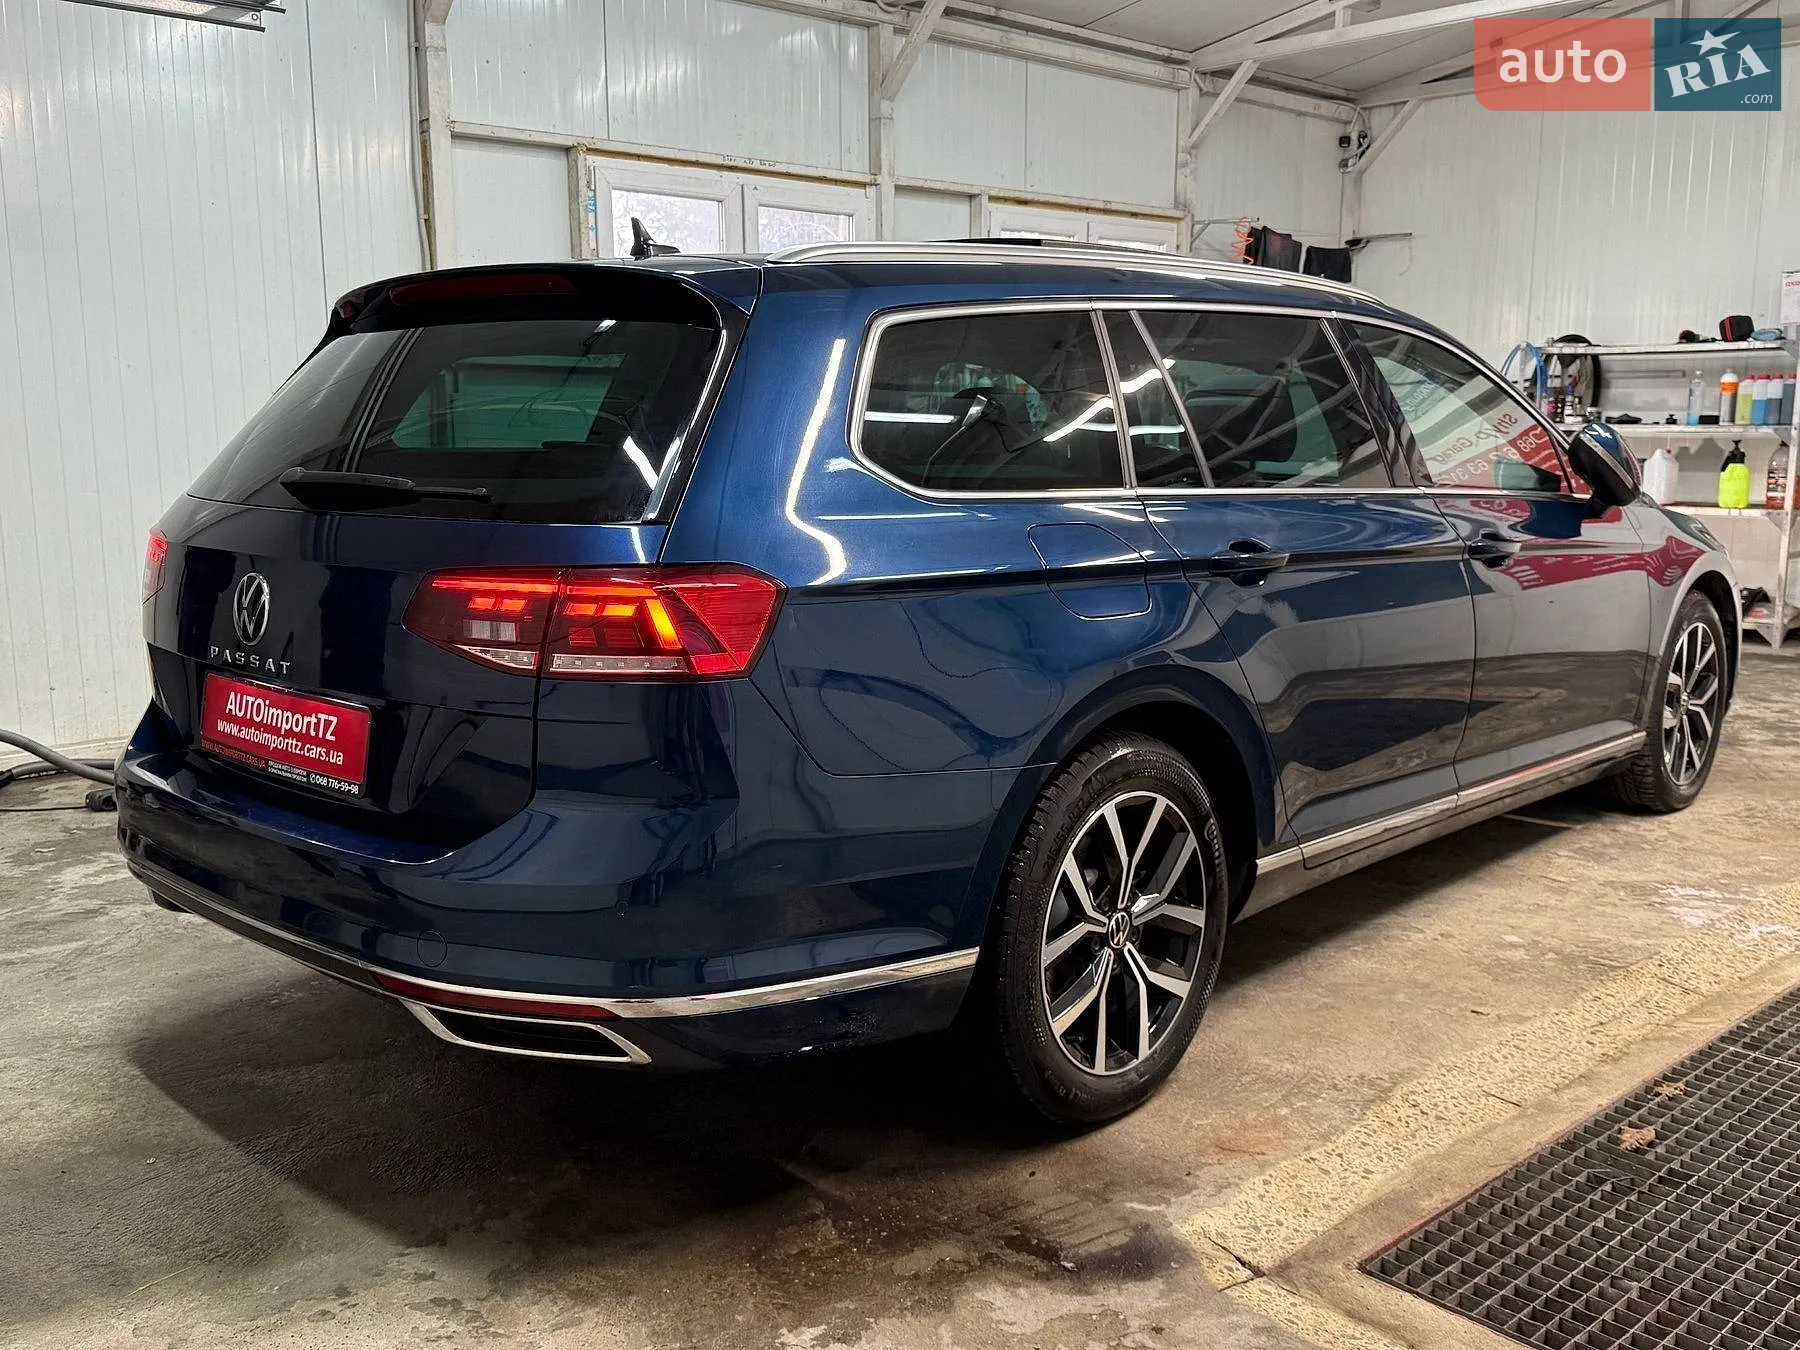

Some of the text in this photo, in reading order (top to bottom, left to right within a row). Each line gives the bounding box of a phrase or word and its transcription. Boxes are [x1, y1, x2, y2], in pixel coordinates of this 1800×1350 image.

[210, 645, 291, 675] PASSAT
[225, 691, 338, 741] AUTOimportTZ
[217, 718, 344, 765] www.autoimporttz.cars.ua
[315, 775, 359, 795] 068 776-59-98
